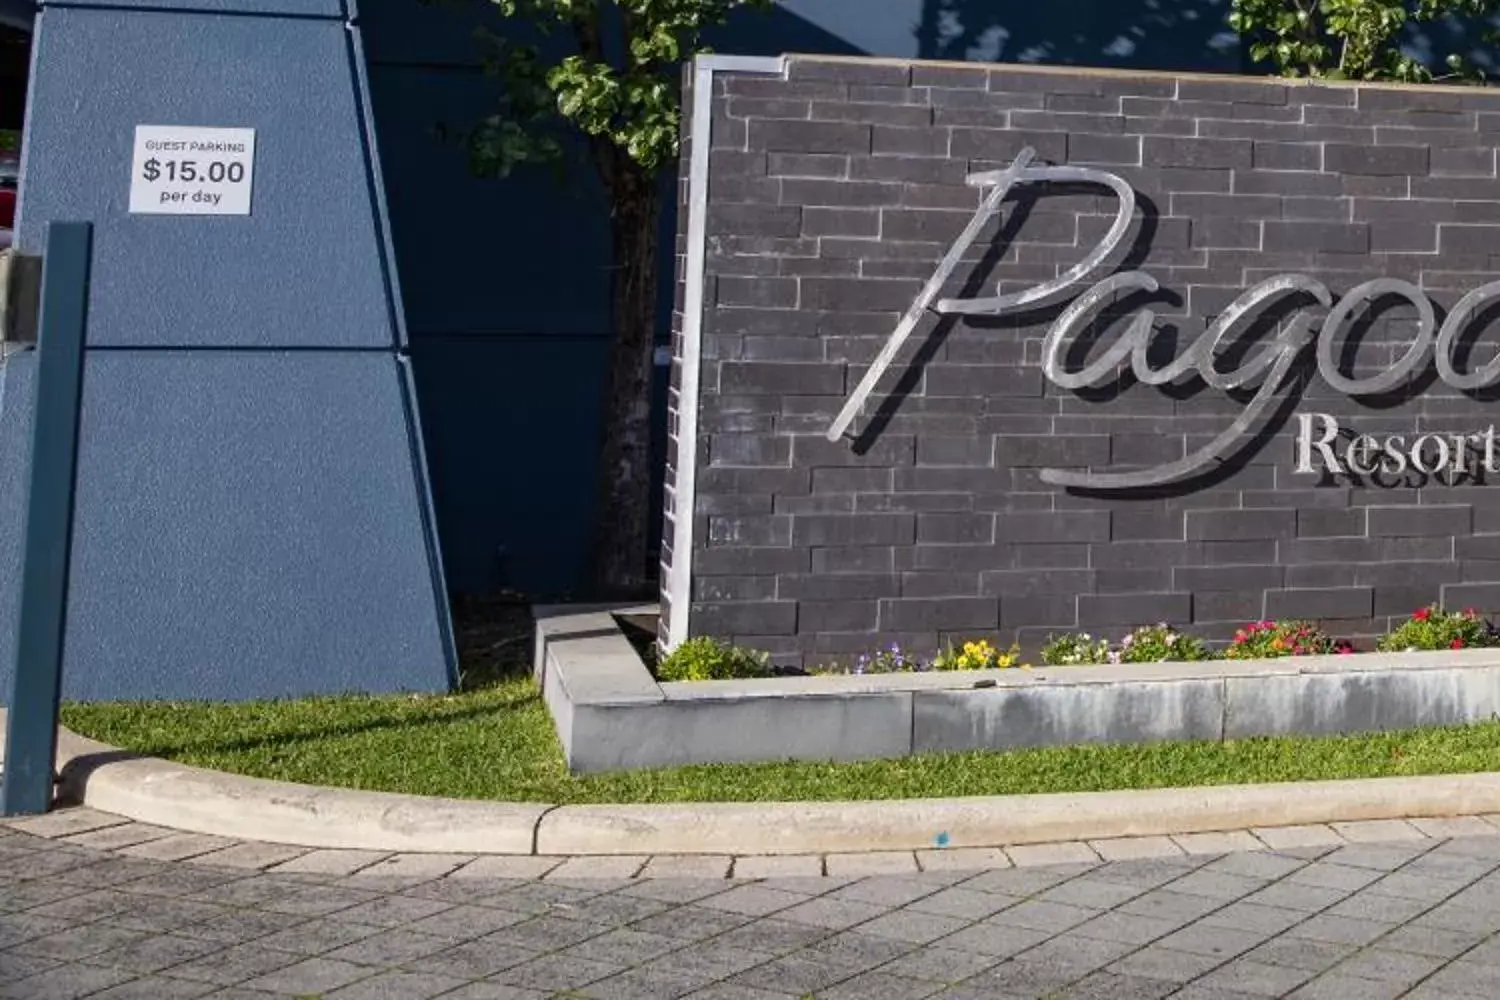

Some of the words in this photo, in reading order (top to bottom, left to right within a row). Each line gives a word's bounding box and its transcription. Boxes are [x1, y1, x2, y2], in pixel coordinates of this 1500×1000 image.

[145, 140, 187, 151] GUEST
[189, 141, 245, 153] PARKING
[142, 157, 245, 183] $15.00
[159, 191, 188, 205] per
[191, 189, 222, 206] day
